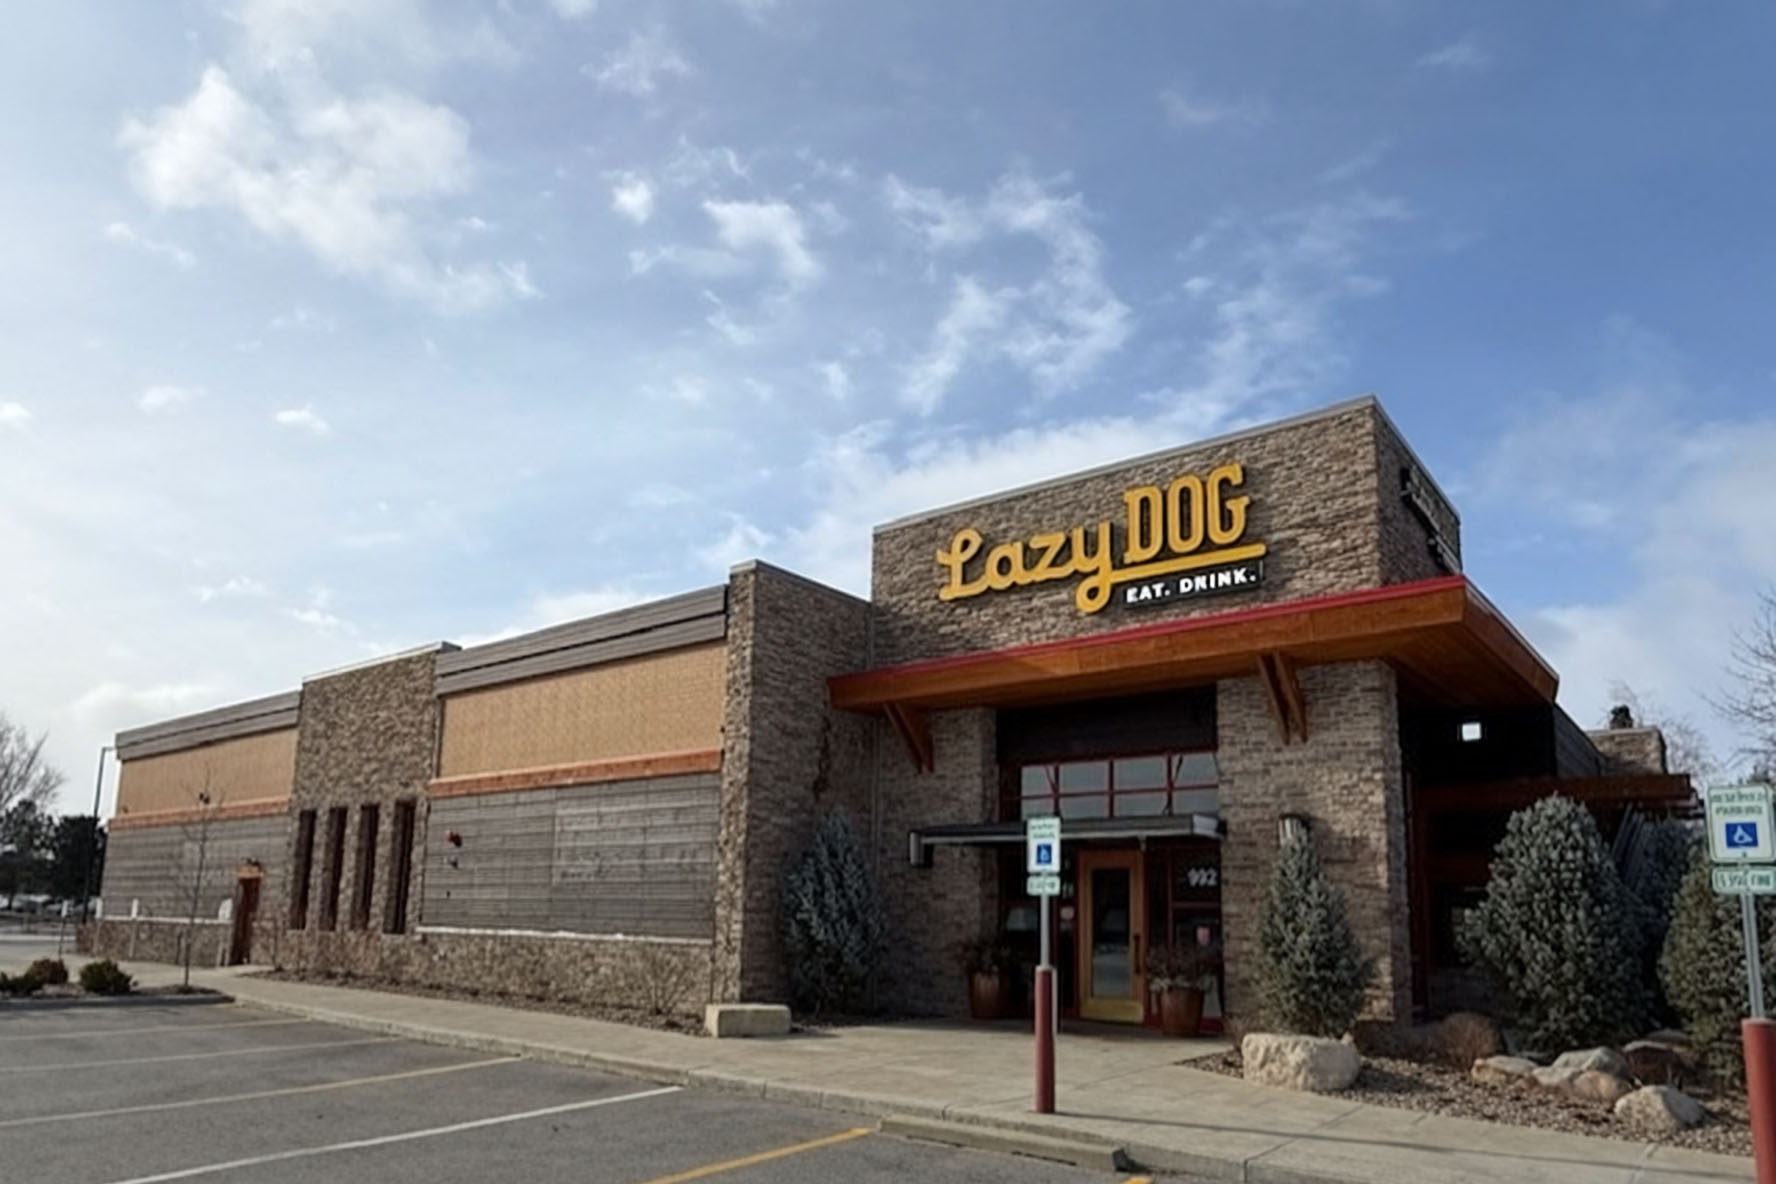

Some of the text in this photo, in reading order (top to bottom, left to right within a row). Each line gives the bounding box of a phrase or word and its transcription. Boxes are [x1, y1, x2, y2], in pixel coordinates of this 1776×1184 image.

[936, 462, 1249, 613] Lazy DOG
[1126, 567, 1257, 603] EAT. DRINK.
